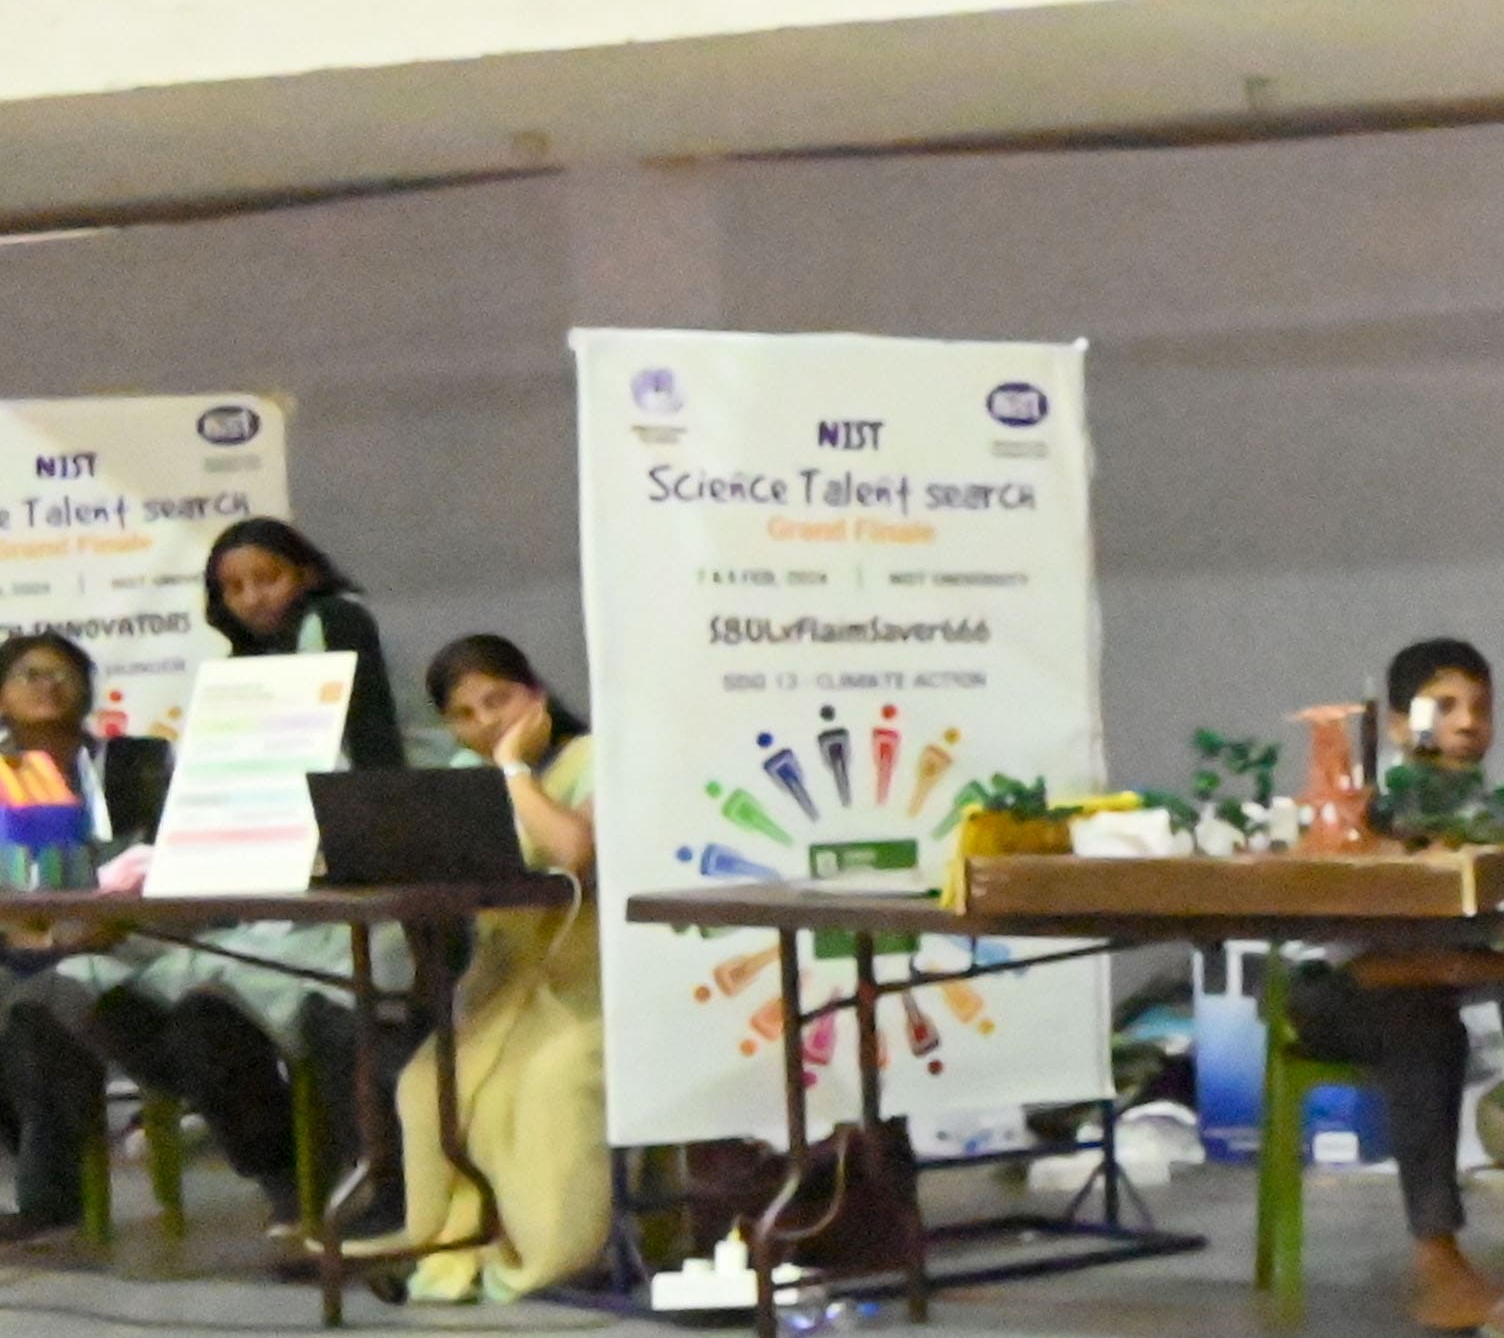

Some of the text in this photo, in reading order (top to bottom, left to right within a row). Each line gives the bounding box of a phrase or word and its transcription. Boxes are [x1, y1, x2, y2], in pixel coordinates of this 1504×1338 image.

[817, 420, 885, 452] NIST
[35, 452, 98, 478] NIST
[647, 465, 1038, 516] Science Talent search
[23, 494, 127, 530] Talent
[142, 491, 251, 523] search
